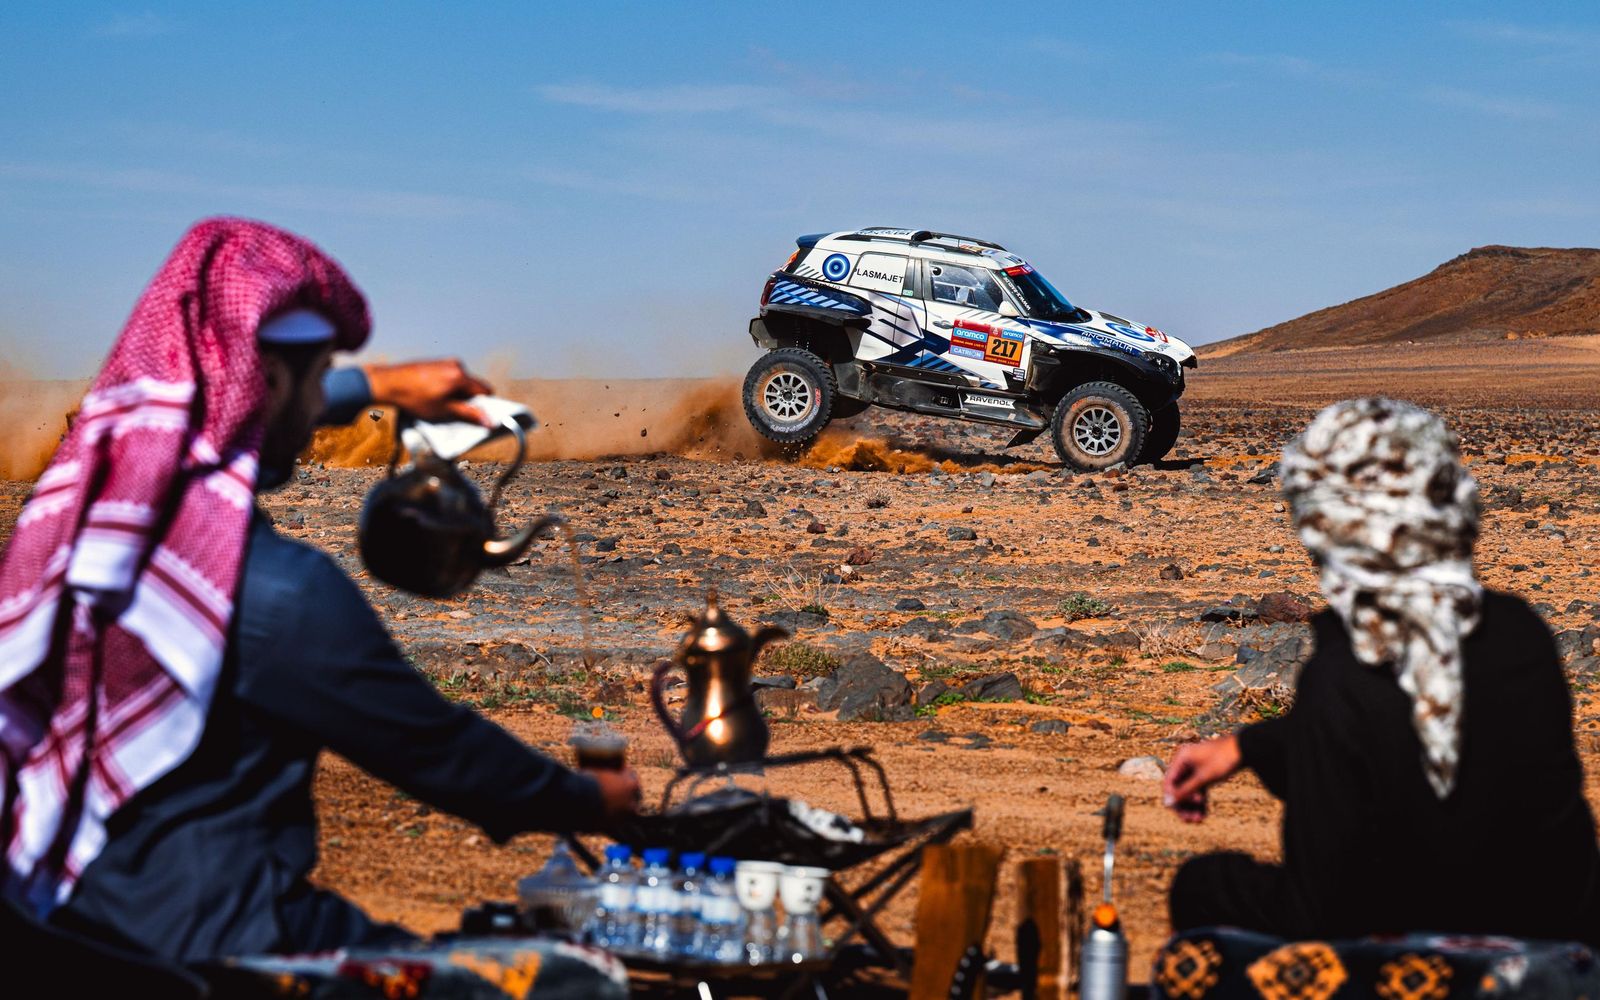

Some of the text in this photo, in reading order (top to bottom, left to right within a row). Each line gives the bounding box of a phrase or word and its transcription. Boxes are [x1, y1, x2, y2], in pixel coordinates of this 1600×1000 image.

[956, 330, 985, 340] aramco
[1003, 331, 1023, 339] aramco
[1081, 330, 1133, 352] ANOMALIA
[953, 347, 981, 358] CATRION
[991, 339, 1018, 358] 217
[969, 396, 1011, 406] RAVENOL
